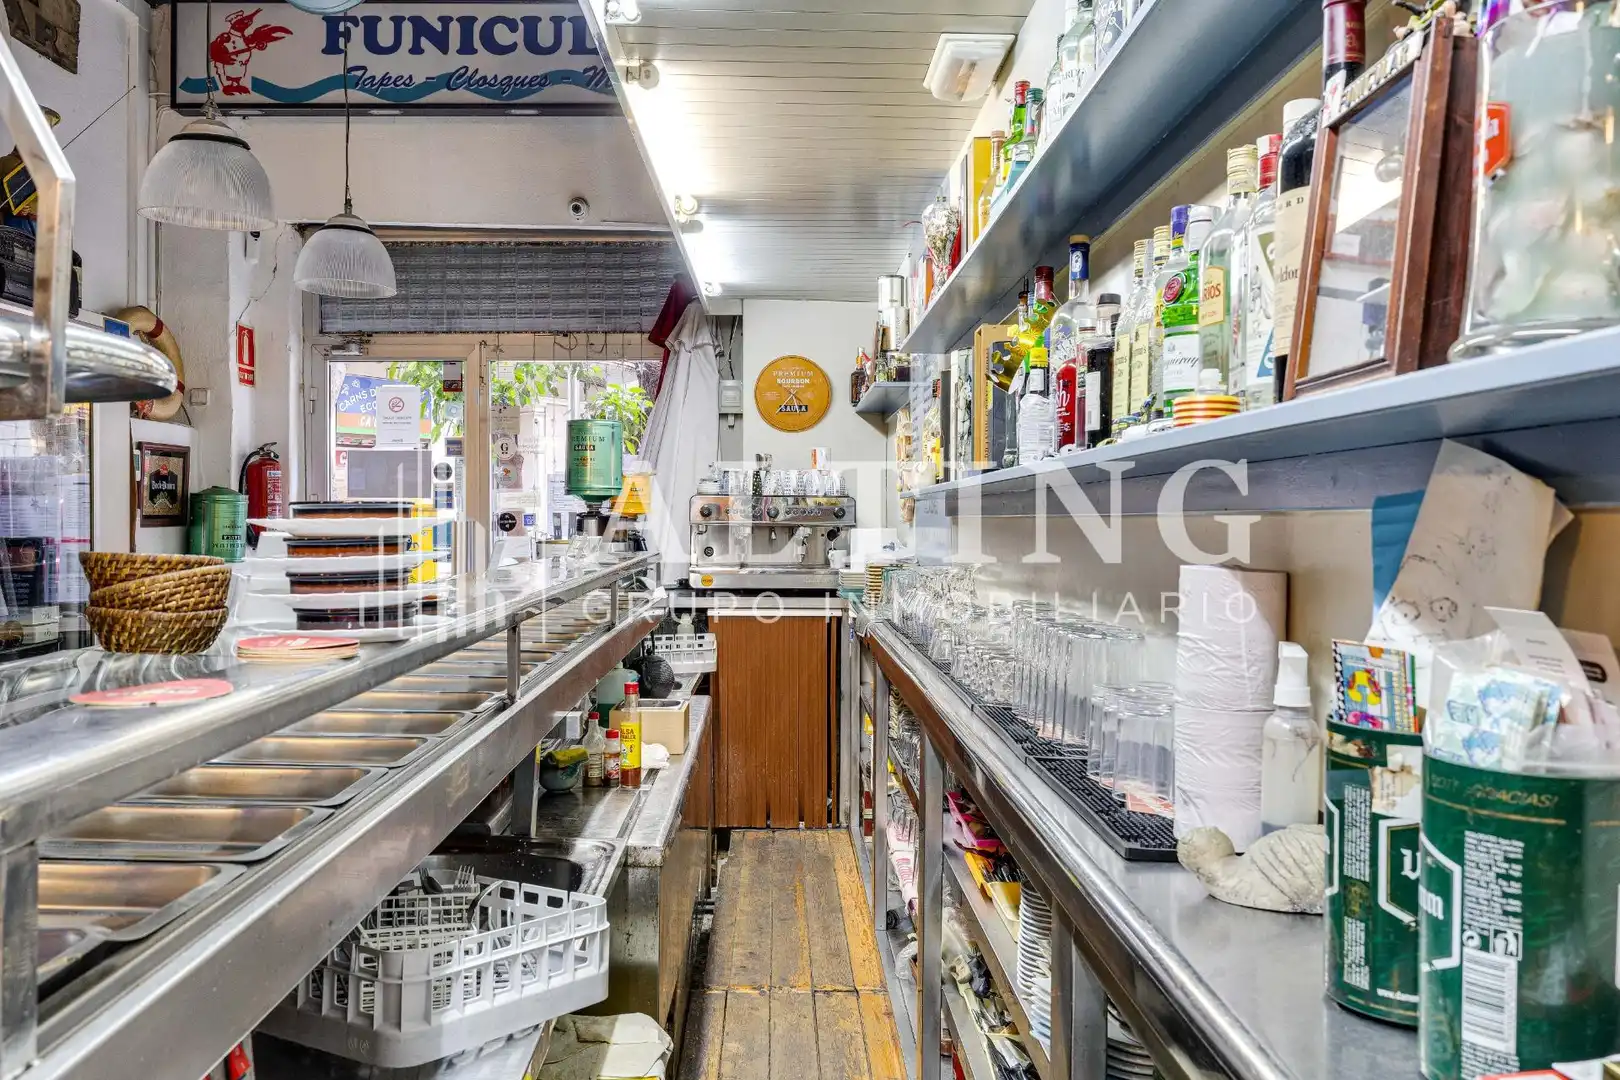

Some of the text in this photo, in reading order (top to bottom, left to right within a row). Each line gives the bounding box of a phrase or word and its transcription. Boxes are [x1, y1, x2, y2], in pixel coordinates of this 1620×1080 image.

[346, 65, 415, 95] Tapes
[445, 65, 552, 96] Closques
[339, 390, 368, 412] CARNS
